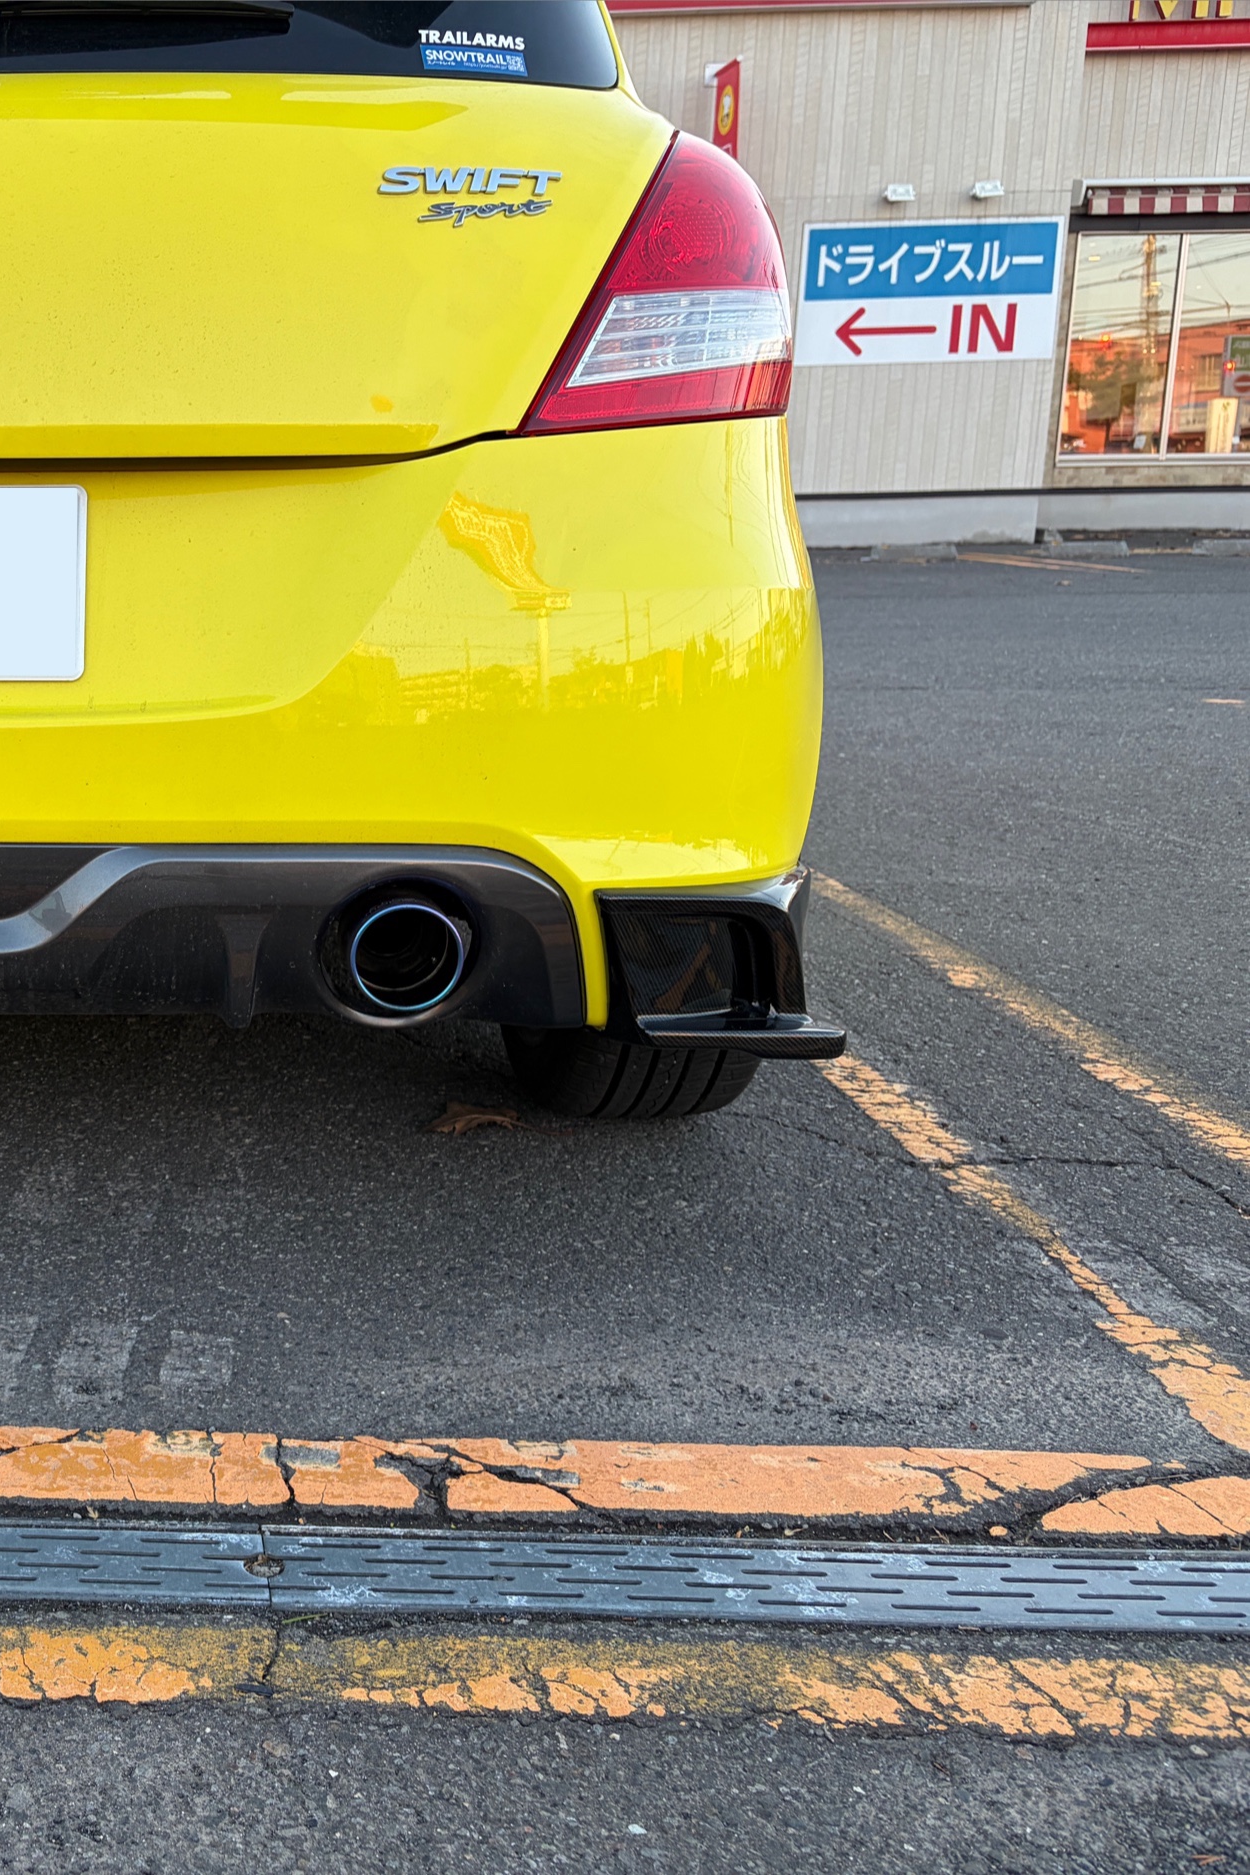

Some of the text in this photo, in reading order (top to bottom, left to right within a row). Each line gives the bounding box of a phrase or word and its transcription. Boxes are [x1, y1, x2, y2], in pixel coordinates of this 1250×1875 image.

[418, 29, 525, 50] TRAILARMS
[425, 50, 507, 65] SNOWTRAIL
[377, 166, 562, 196] SWIFT
[417, 199, 552, 228] Sport
[817, 239, 1044, 288] ドライブスルー
[948, 303, 1018, 354] IN
